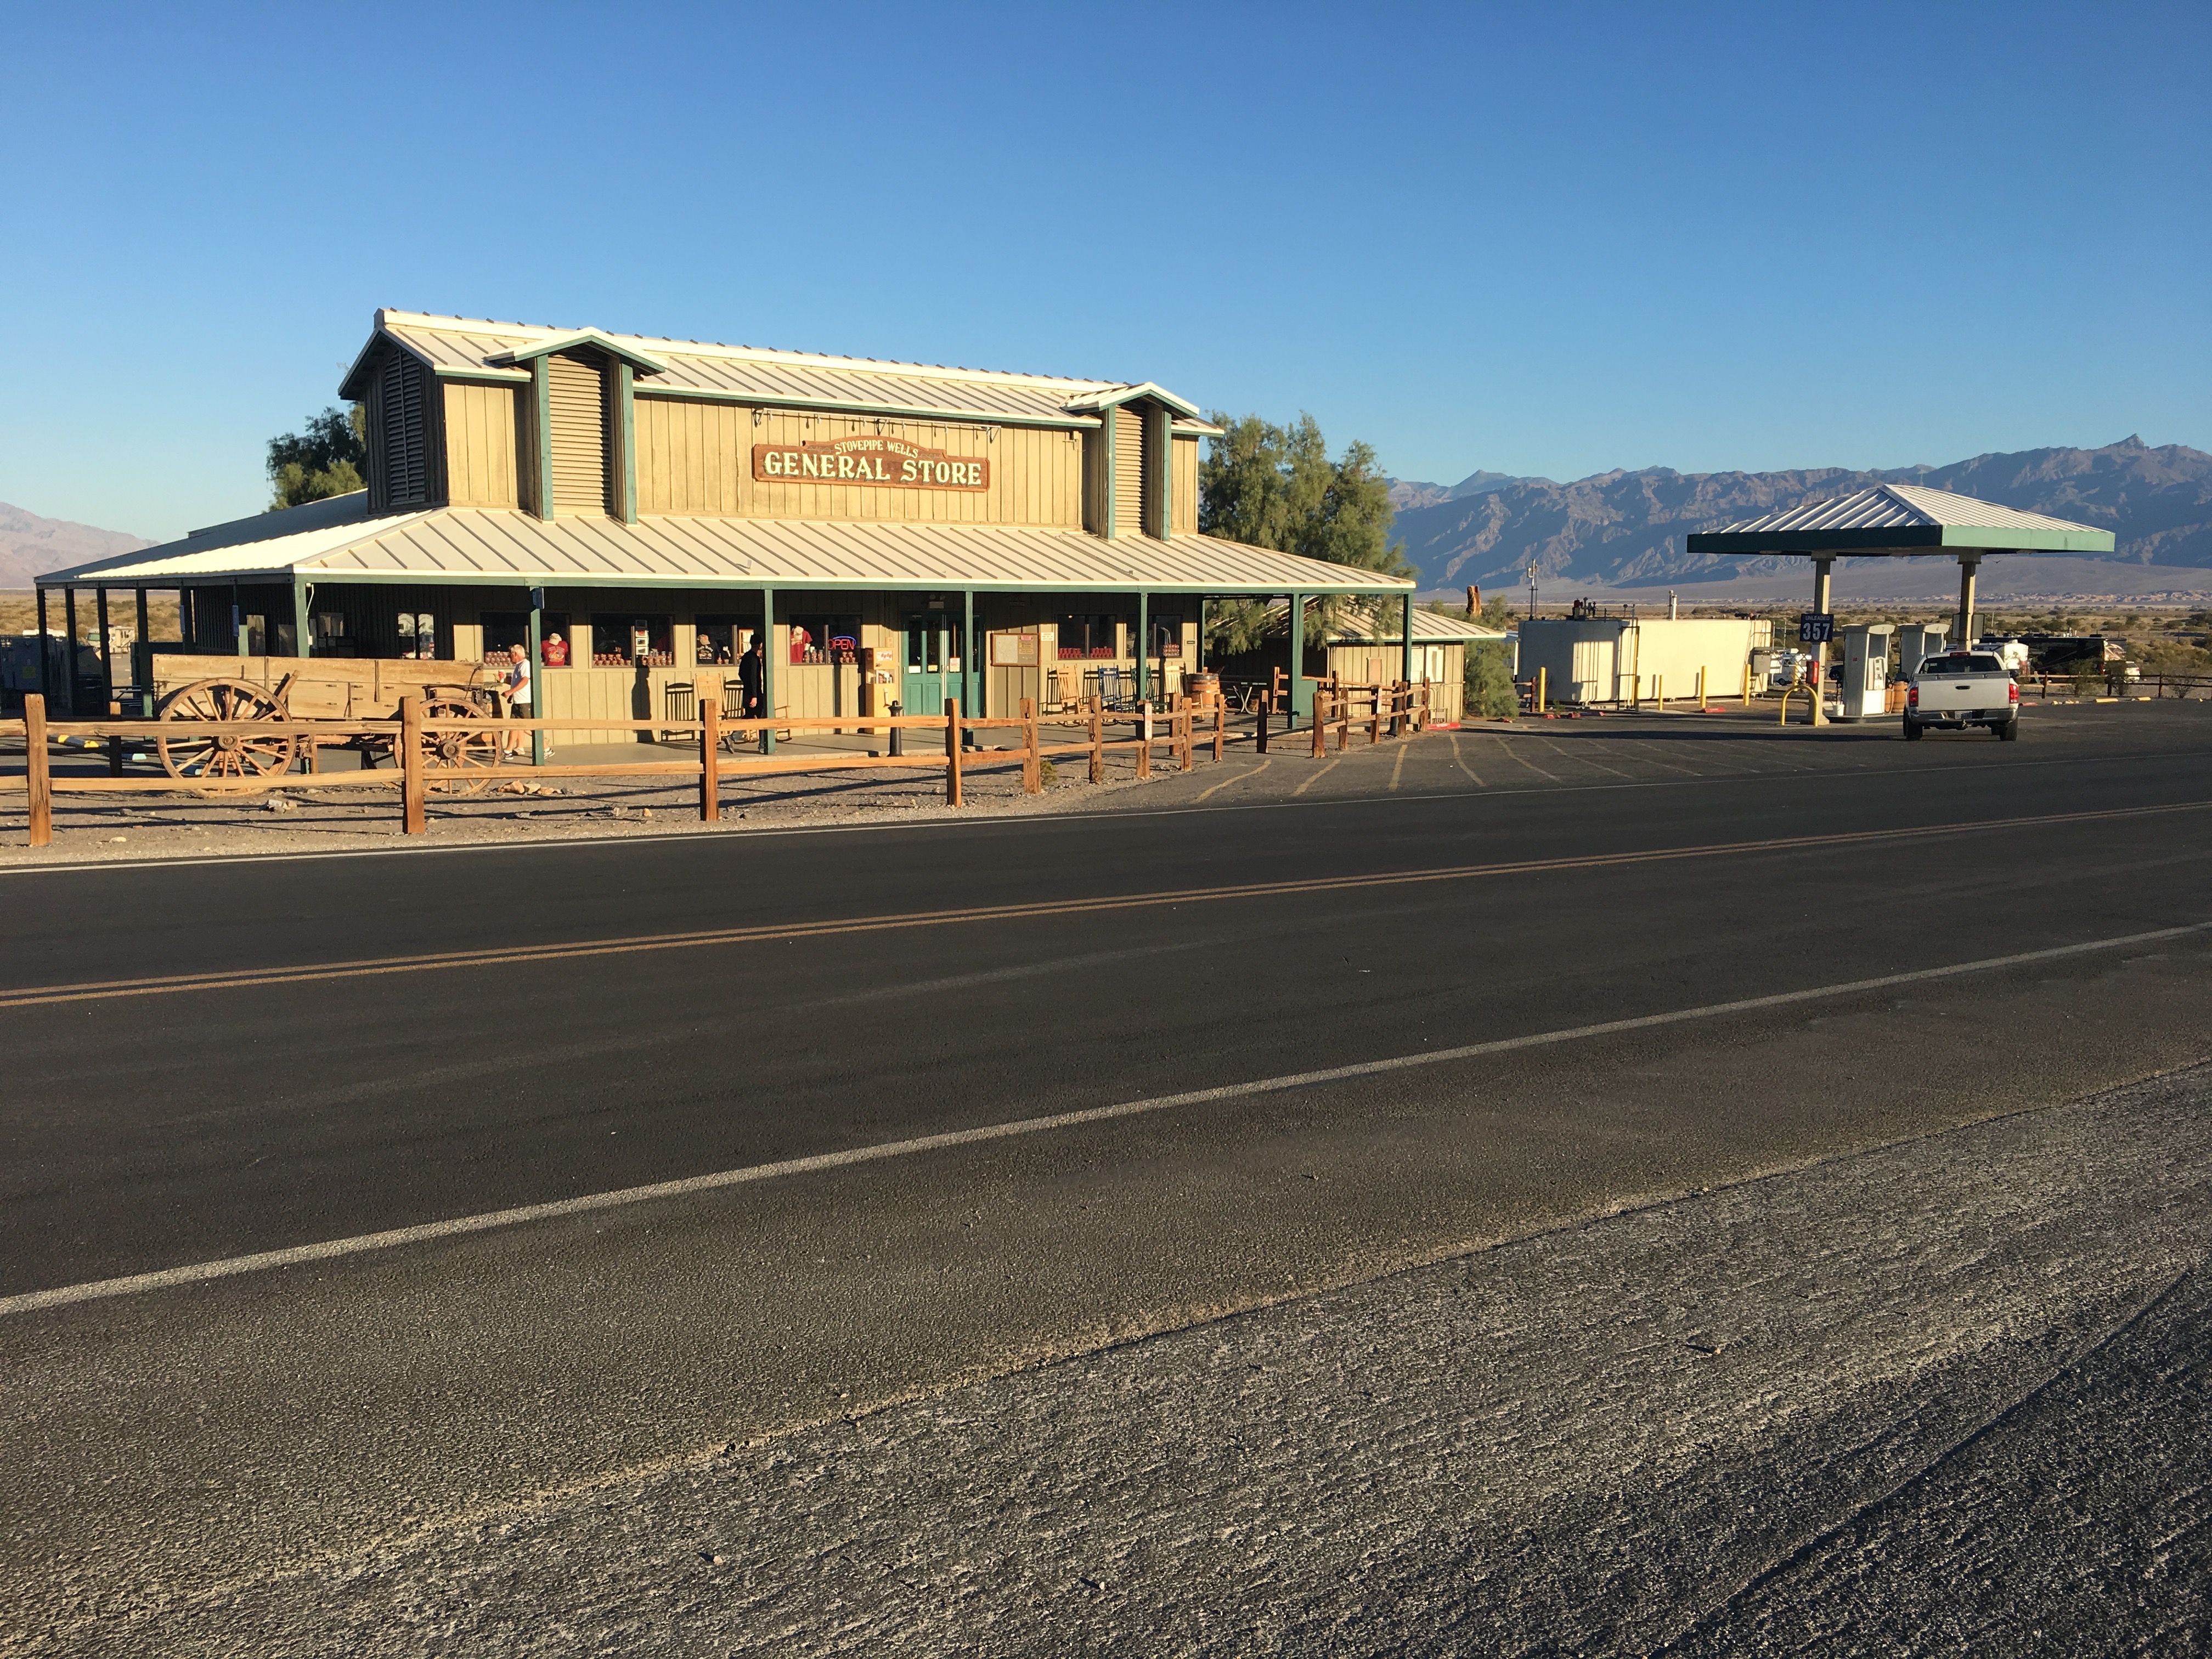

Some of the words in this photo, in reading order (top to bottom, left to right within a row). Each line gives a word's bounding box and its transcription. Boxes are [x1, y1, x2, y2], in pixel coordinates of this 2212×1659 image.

[834, 439, 883, 455] STOVEPIPE
[887, 441, 919, 459] WELLS
[764, 452, 890, 481] GENERAL
[900, 460, 981, 486] STORE
[1803, 623, 1830, 640] 357
[828, 639, 855, 650] OPEN
